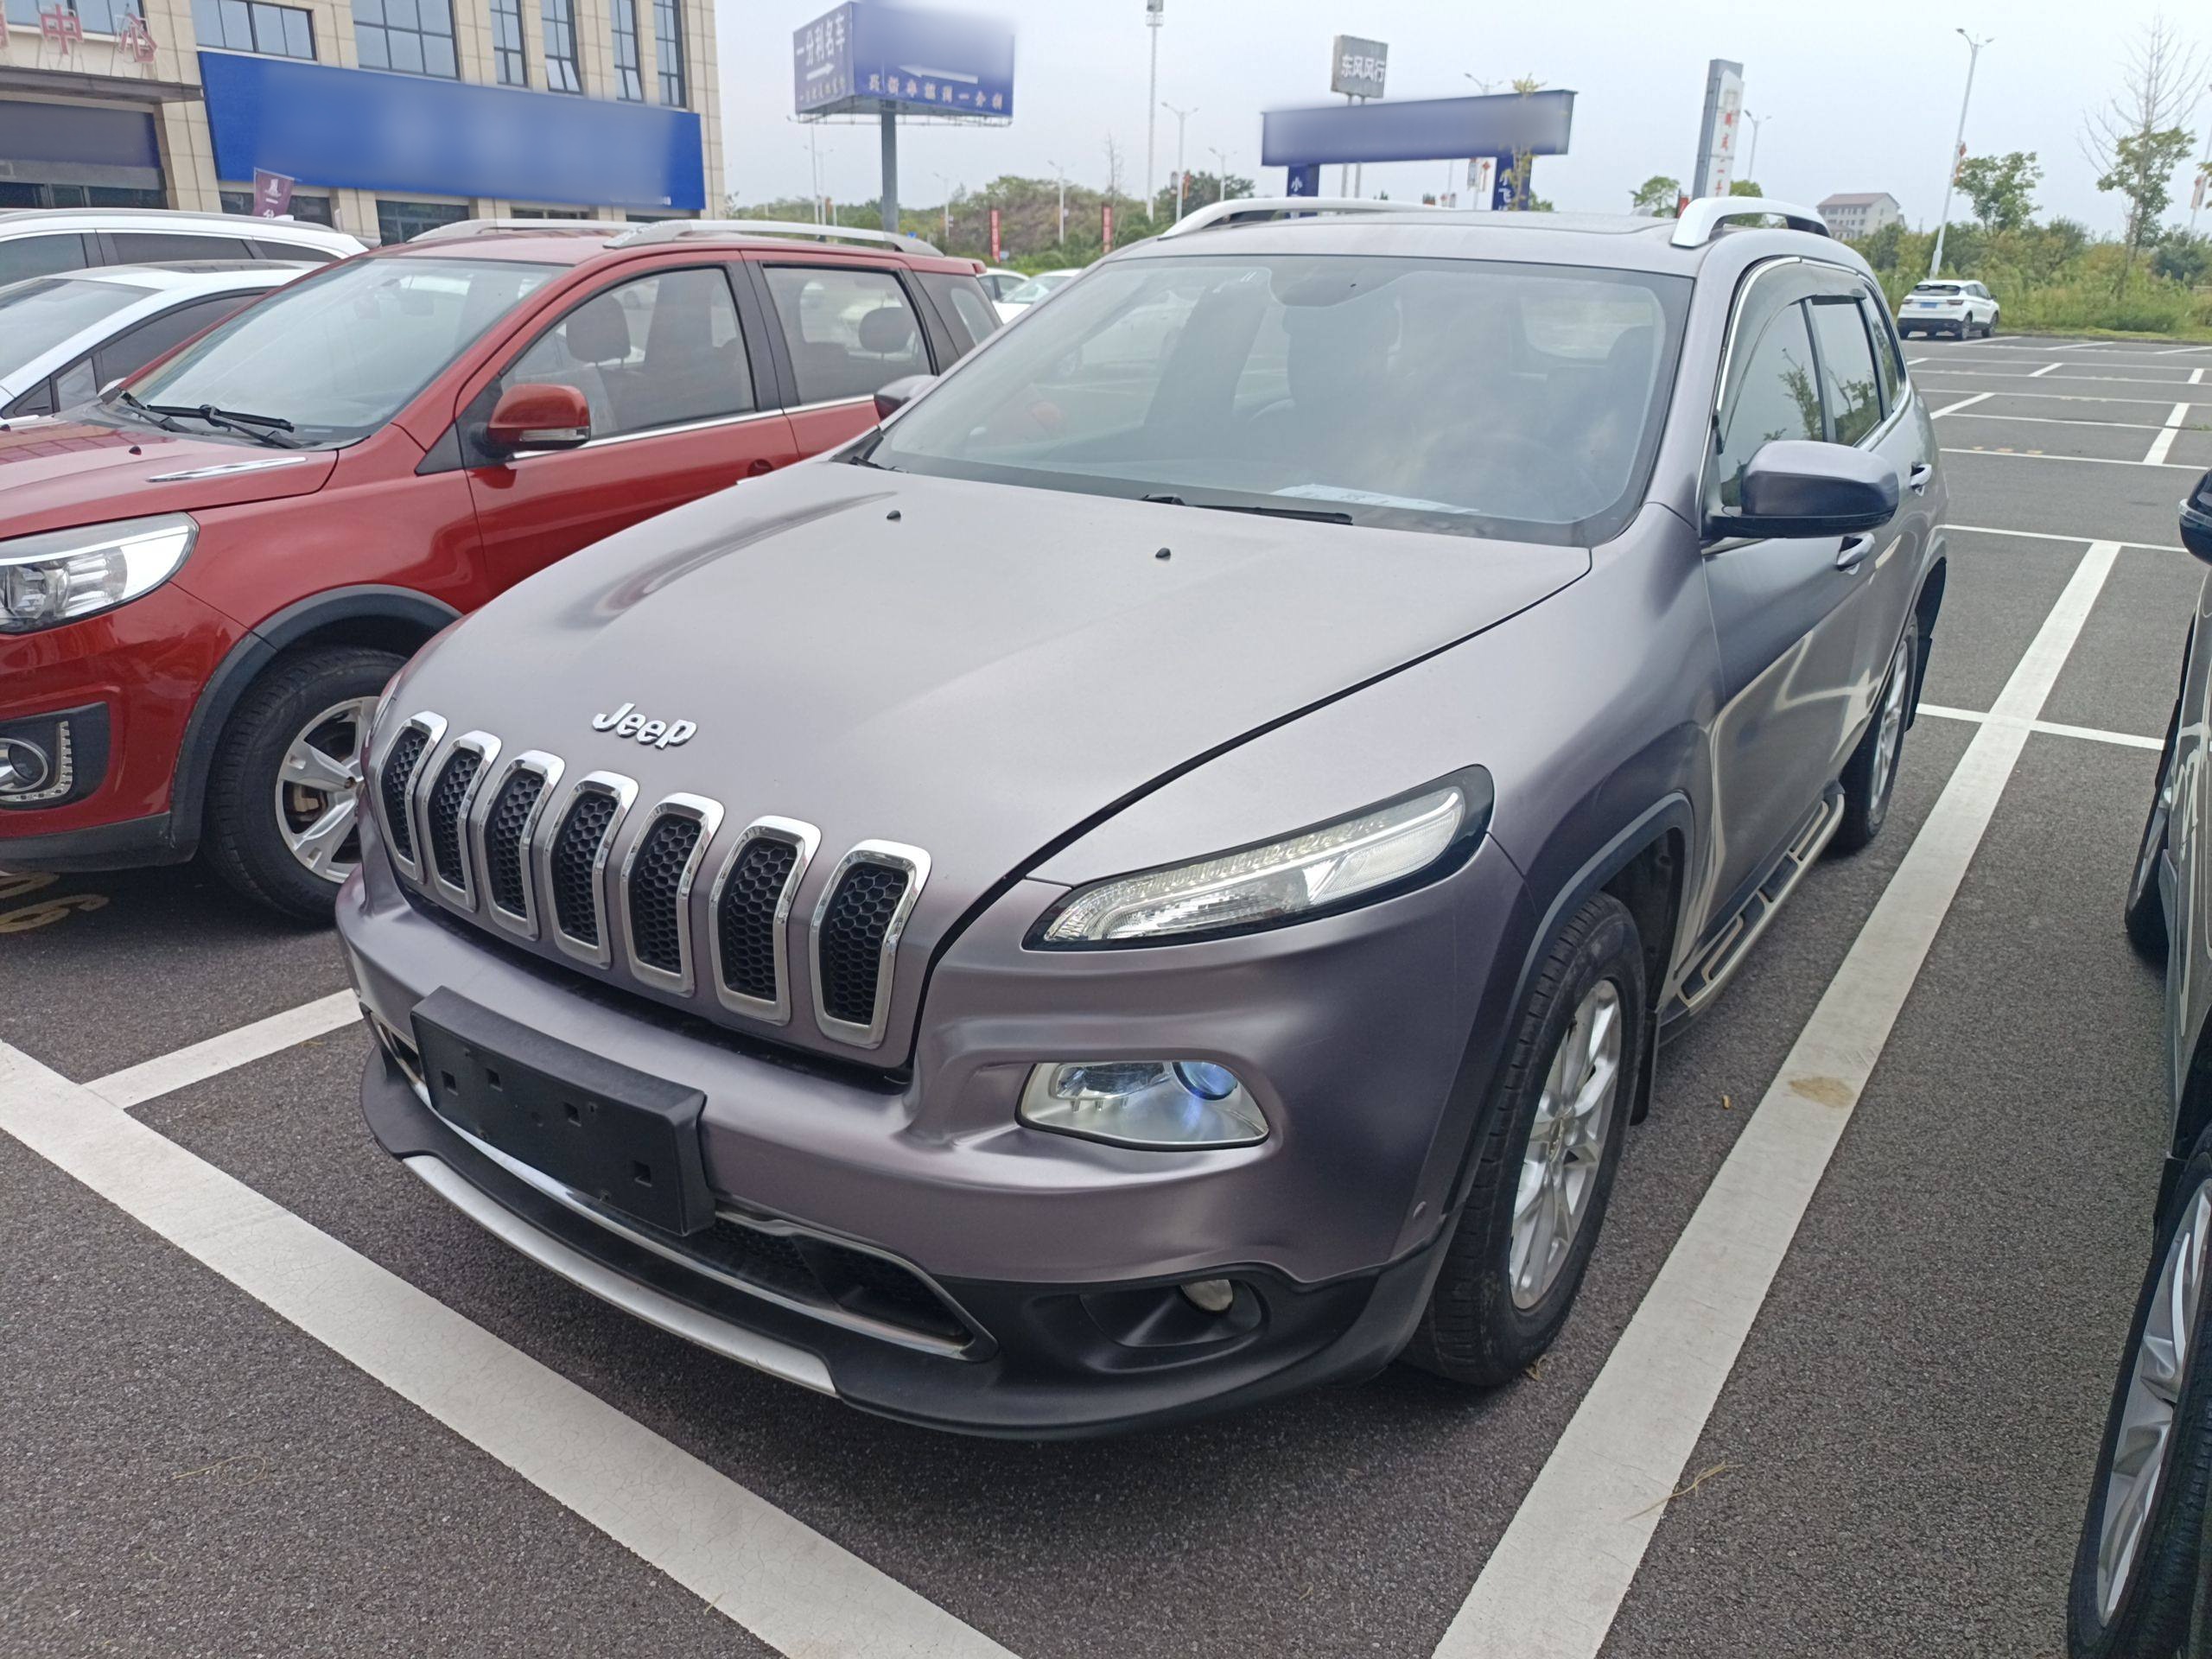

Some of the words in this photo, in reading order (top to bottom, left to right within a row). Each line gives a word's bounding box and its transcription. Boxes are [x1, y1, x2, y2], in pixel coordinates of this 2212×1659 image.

[797, 14, 845, 66] 一分利名车
[1342, 54, 1386, 83] 东风风行
[593, 702, 697, 750] Jeep
